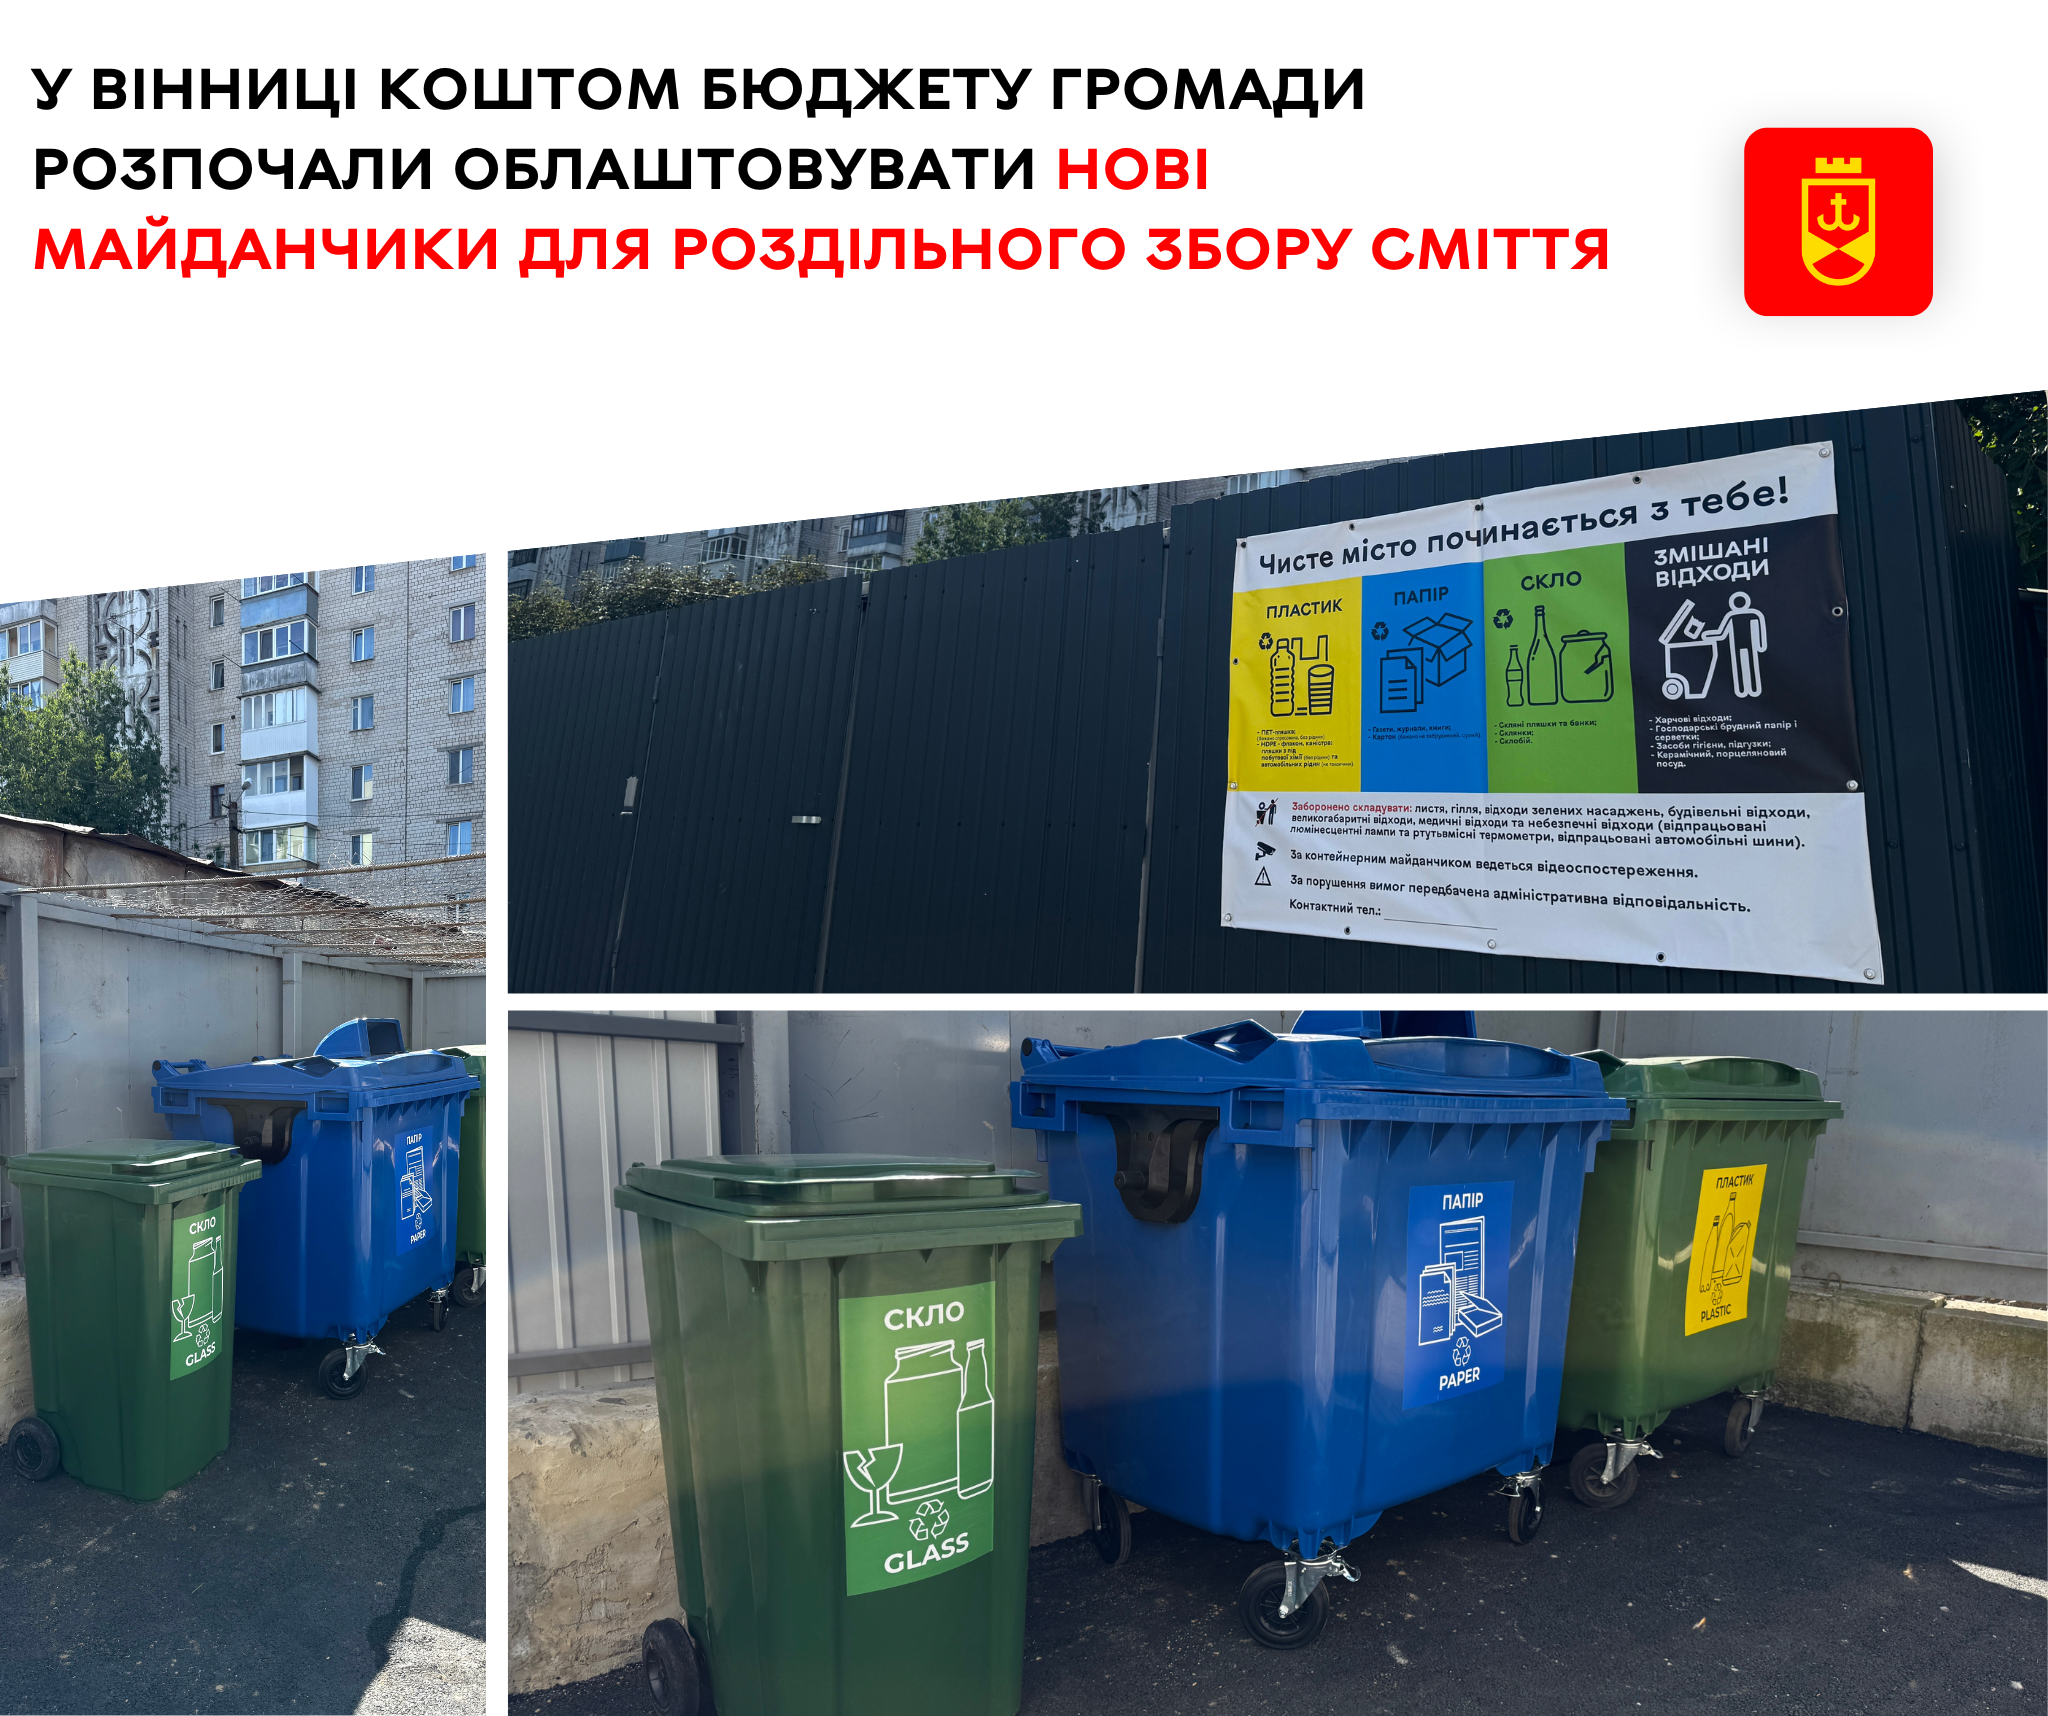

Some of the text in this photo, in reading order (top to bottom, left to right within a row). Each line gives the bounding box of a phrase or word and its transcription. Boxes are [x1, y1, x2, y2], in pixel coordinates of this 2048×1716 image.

[1259, 475, 1789, 575] Чисте місто починається з тебе!
[1654, 536, 1769, 566] ЗМІШАНІ
[1520, 570, 1582, 591] СКЛО
[1655, 558, 1770, 588] ВІДХОДИ
[1394, 586, 1449, 605] ПАПІР
[1266, 598, 1343, 620] ПЛАСТИК
[1498, 720, 1525, 728] Скляні
[1570, 719, 1597, 727] банки;
[1654, 714, 1691, 724] Харчові
[1655, 720, 1798, 733] Господарські брудний папір і
[1499, 736, 1533, 744] Склобій.
[1692, 740, 1726, 750] гігієни,
[1728, 740, 1772, 750] підгузки;
[1657, 748, 1787, 759] Керамічний, порцеляновий
[1656, 760, 1686, 769] посуд.
[1292, 802, 1811, 820] Заборонено складувати: листя, гілля, відходи зелених насаджень, будівельні відходи,
[1292, 814, 1767, 834] великогабаритні відходи, медичні відходи та небезпечні відходи (відпрацьовані
[1290, 824, 1806, 850] люмінесцентні лампи та ртутьвмісні термометри, відпрацьовані автомобільні шини).
[1290, 850, 1698, 879] За контейнерним майданчиком ведеться відеоспостереження.
[1290, 875, 1751, 912] За порушення вимог передбачена адміністративна відповідальність.
[1289, 899, 1382, 916] Контактний тел.:
[406, 1132, 422, 1145] ПАПІР
[1716, 1173, 1756, 1190] ПЛАСТИК
[1442, 1192, 1484, 1210] ПАПІР
[189, 1216, 216, 1235] СКЛО
[410, 1229, 426, 1244] PAPER
[884, 1301, 965, 1331] СКЛО
[1700, 1302, 1732, 1322] PLASTIC
[186, 1342, 216, 1367] GLASS
[1439, 1367, 1480, 1391] PAPER
[884, 1532, 969, 1574] GLASS
